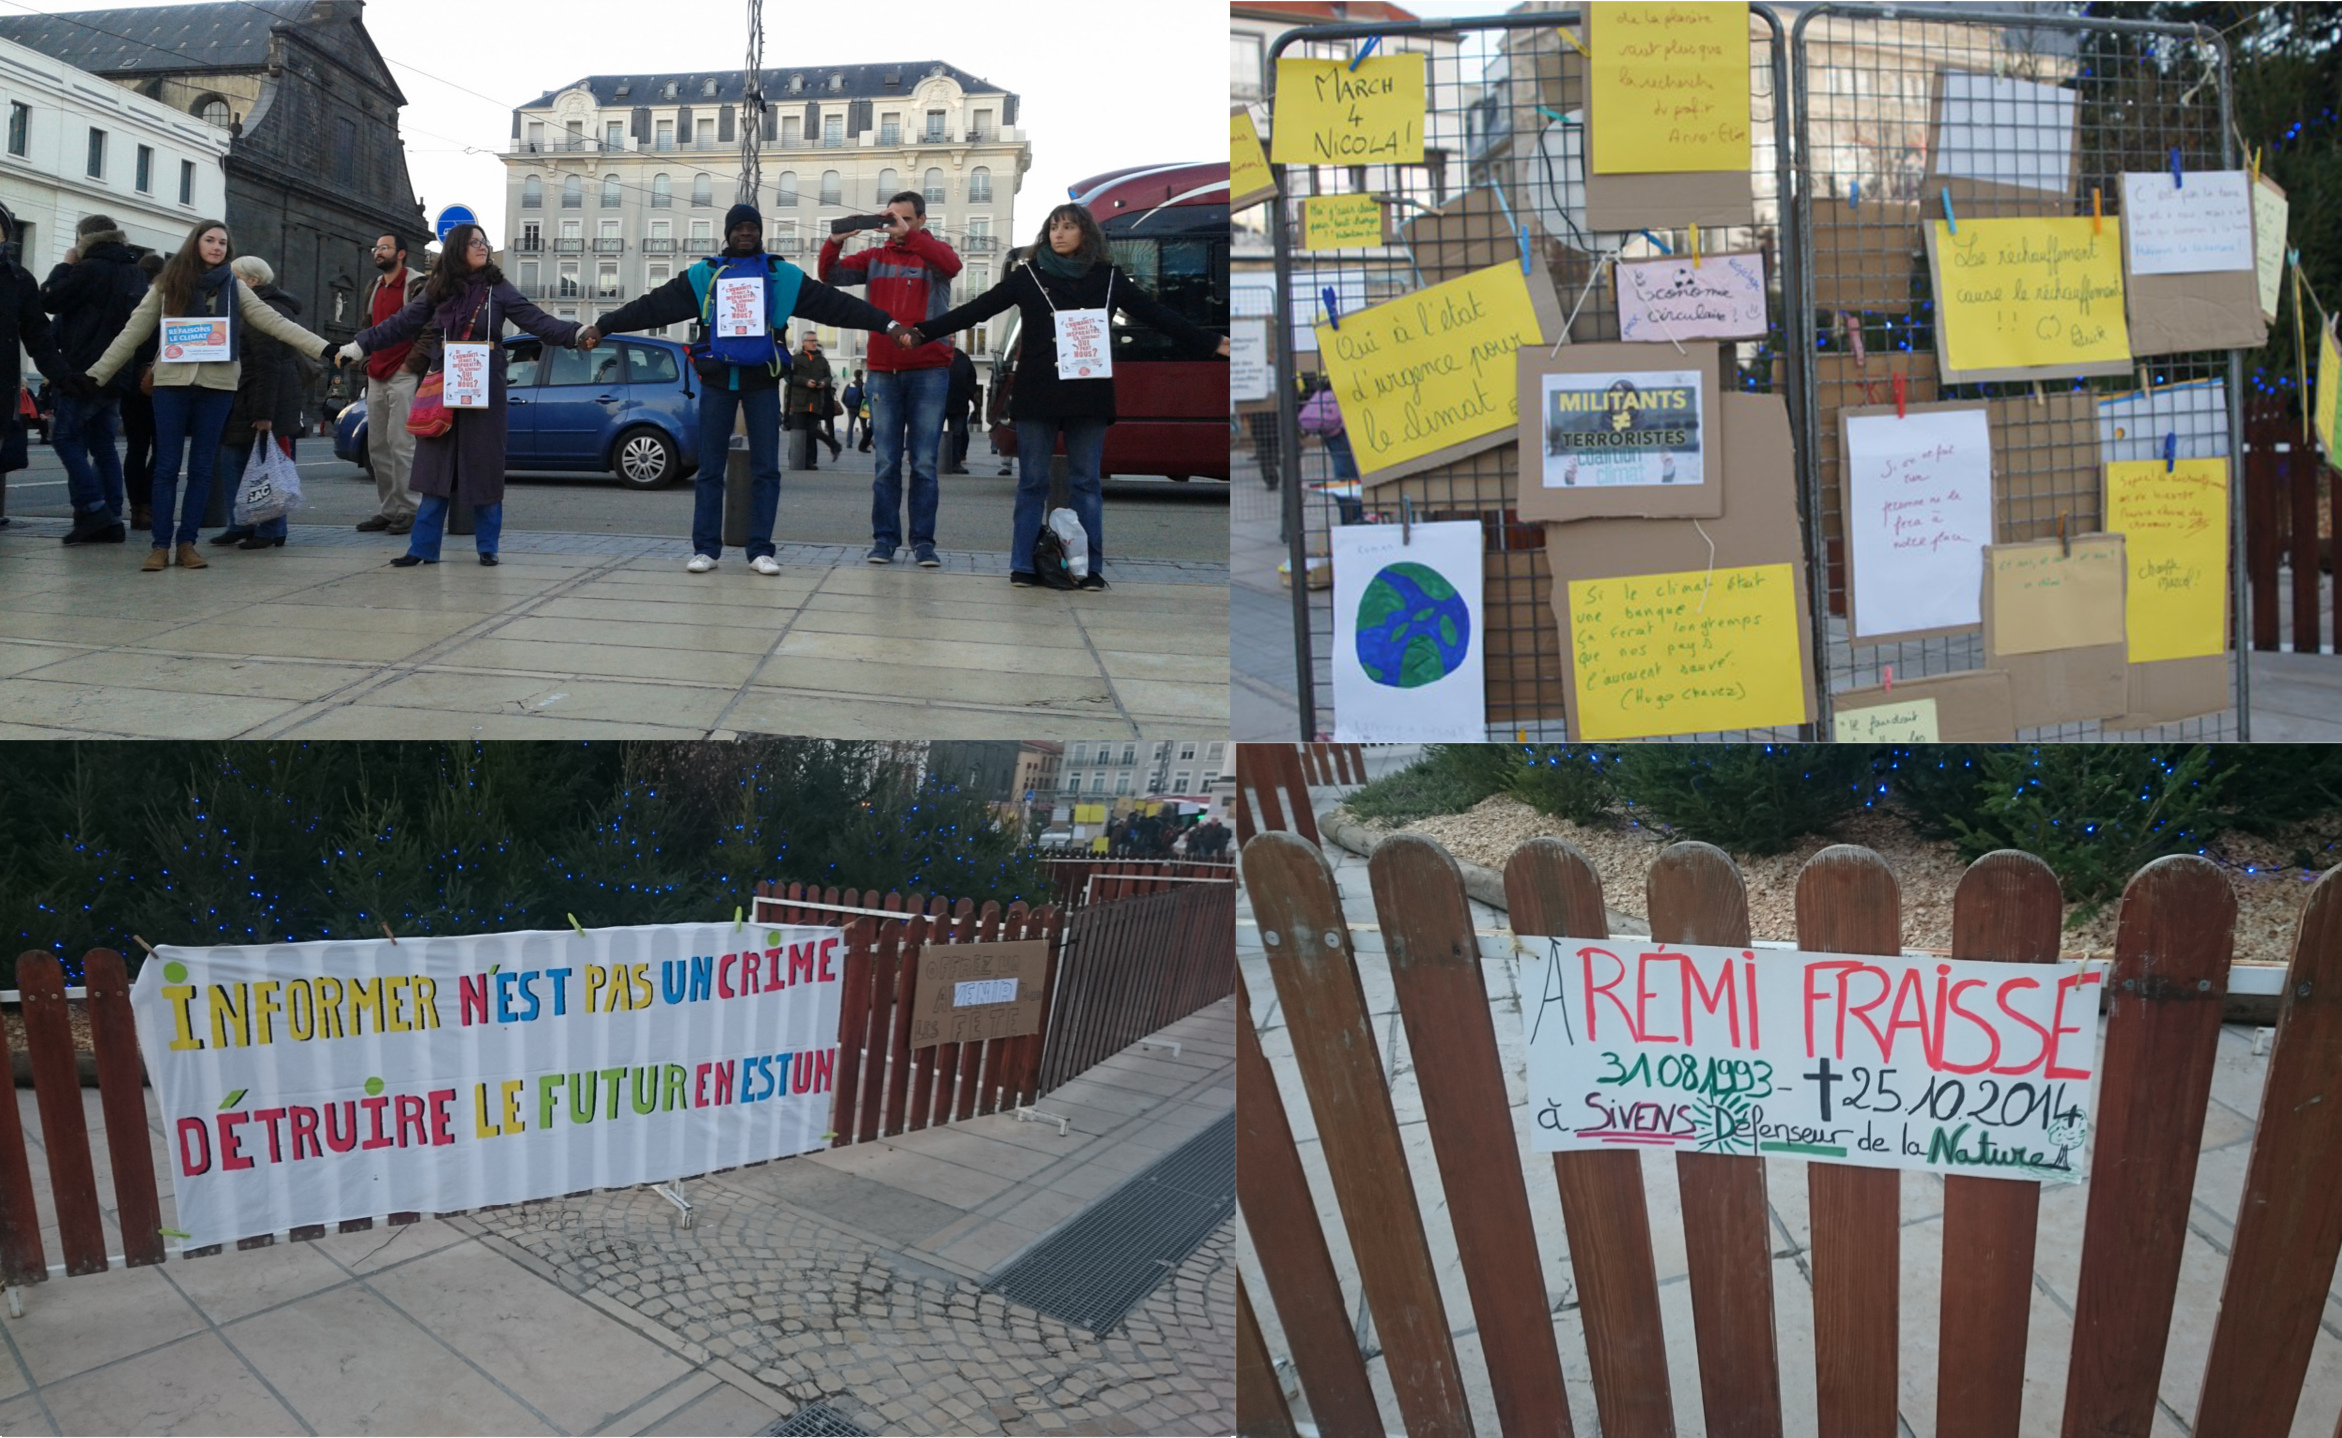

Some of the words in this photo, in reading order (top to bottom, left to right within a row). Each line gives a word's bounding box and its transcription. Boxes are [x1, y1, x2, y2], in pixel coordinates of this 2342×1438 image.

[1315, 66, 1393, 103] MARCH
[1348, 104, 1363, 128] 4
[168, 326, 211, 335] REFAISONS
[179, 333, 208, 341] CLIMAT
[1393, 316, 1413, 344] à
[1470, 331, 1525, 378] pour
[1559, 390, 1688, 412] MILITANTS
[1363, 408, 1393, 454] le
[1402, 379, 1496, 443] climat
[1562, 431, 1686, 447] TERRORISTES
[1586, 586, 1603, 605] Si
[1624, 584, 1637, 600] le
[1577, 611, 1602, 624] une
[1626, 604, 1685, 623] banque
[1673, 615, 1762, 637] longtemps
[1619, 645, 1647, 657] nos
[1667, 638, 1713, 658] pays
[926, 954, 993, 980] OFFREZ
[161, 962, 441, 1051] INFORMER
[459, 964, 573, 1027] N'EST
[585, 963, 654, 1014] PAS
[662, 956, 714, 1006] UN
[718, 932, 839, 1000] CRIME
[177, 1077, 456, 1177] DÉTRUIRE
[475, 1080, 526, 1139] LE
[539, 1063, 687, 1130] FUTUR
[695, 1059, 735, 1109] EN
[740, 1052, 793, 1104] EST
[792, 1048, 835, 1095] UN
[1537, 1097, 1569, 1132] à
[1699, 1104, 1853, 1156] Défenseur
[1857, 1120, 1890, 1152] de
[1902, 1123, 1928, 1156] la
[1927, 1122, 2062, 1170] Nature
